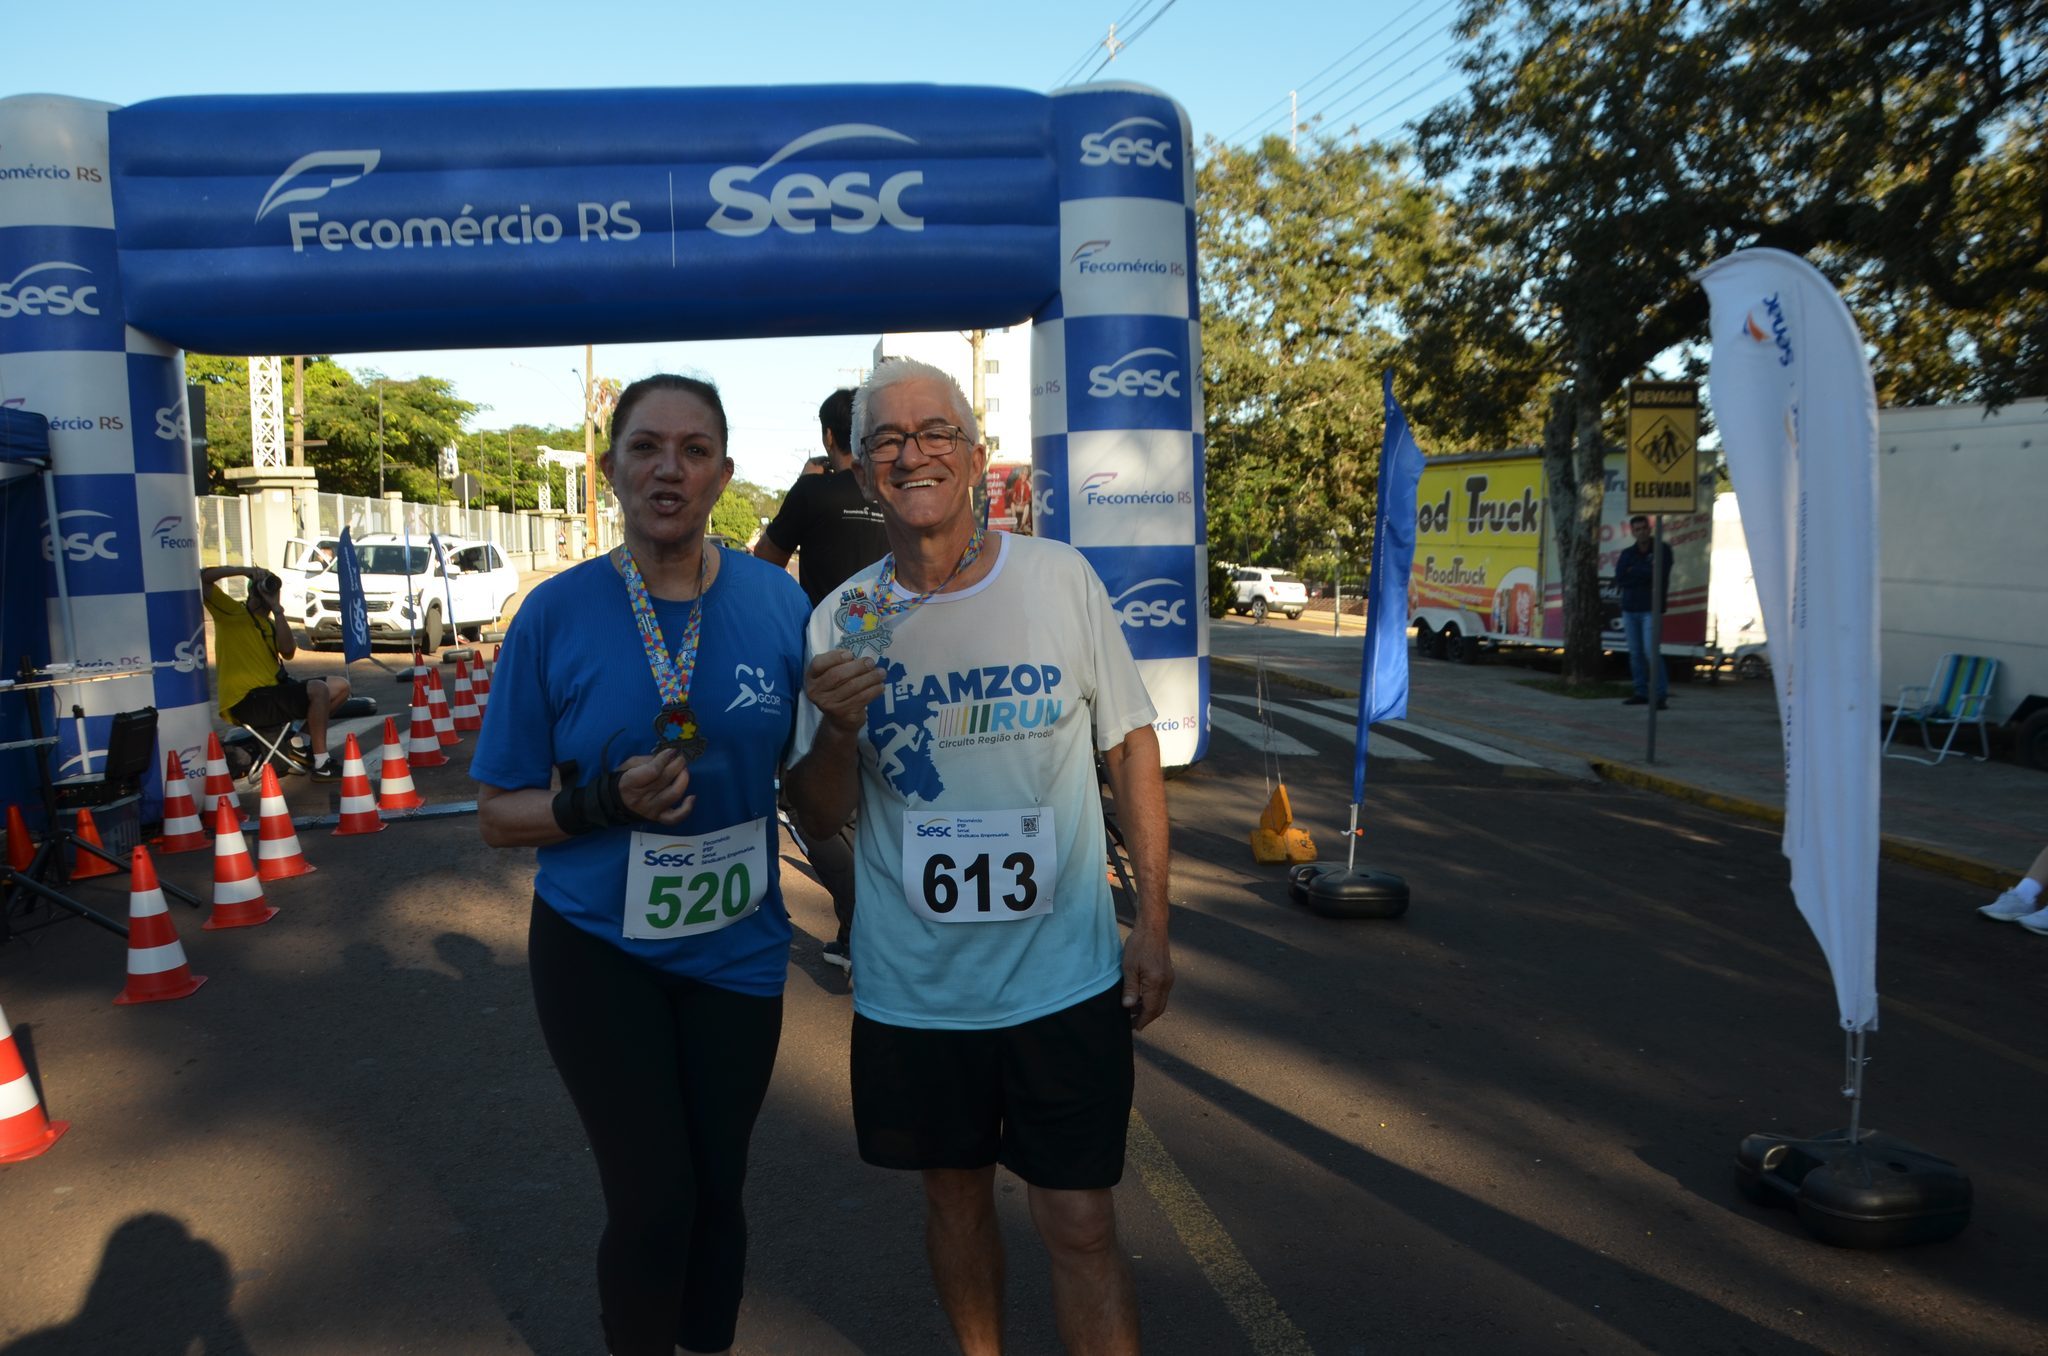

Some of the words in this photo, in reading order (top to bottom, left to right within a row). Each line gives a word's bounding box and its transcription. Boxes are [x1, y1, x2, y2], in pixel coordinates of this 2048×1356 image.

[1080, 133, 1172, 169] Sesc
[76, 166, 102, 183] RS
[706, 166, 924, 238] Sesc
[288, 205, 563, 252] Fecomércio
[578, 202, 641, 243] RS
[1079, 258, 1167, 275] Fecomércio
[1170, 262, 1185, 277] RS
[1087, 365, 1181, 398] Sesc
[99, 416, 124, 430] RS
[1088, 490, 1174, 506] Fecomércio
[1177, 491, 1192, 505] RS
[1634, 482, 1692, 498] ELEVADA
[1416, 489, 1451, 533] od
[1465, 475, 1538, 534] Truck
[920, 664, 1062, 704] AMZOP
[991, 698, 1062, 732] RUN
[1182, 716, 1197, 729] RS
[938, 737, 975, 749] Circuito
[978, 733, 1011, 745] Região
[1013, 732, 1026, 741] da
[917, 825, 951, 838] Sesc
[644, 850, 695, 868] Sesc
[923, 852, 1038, 913] 613
[645, 863, 751, 929] 520
